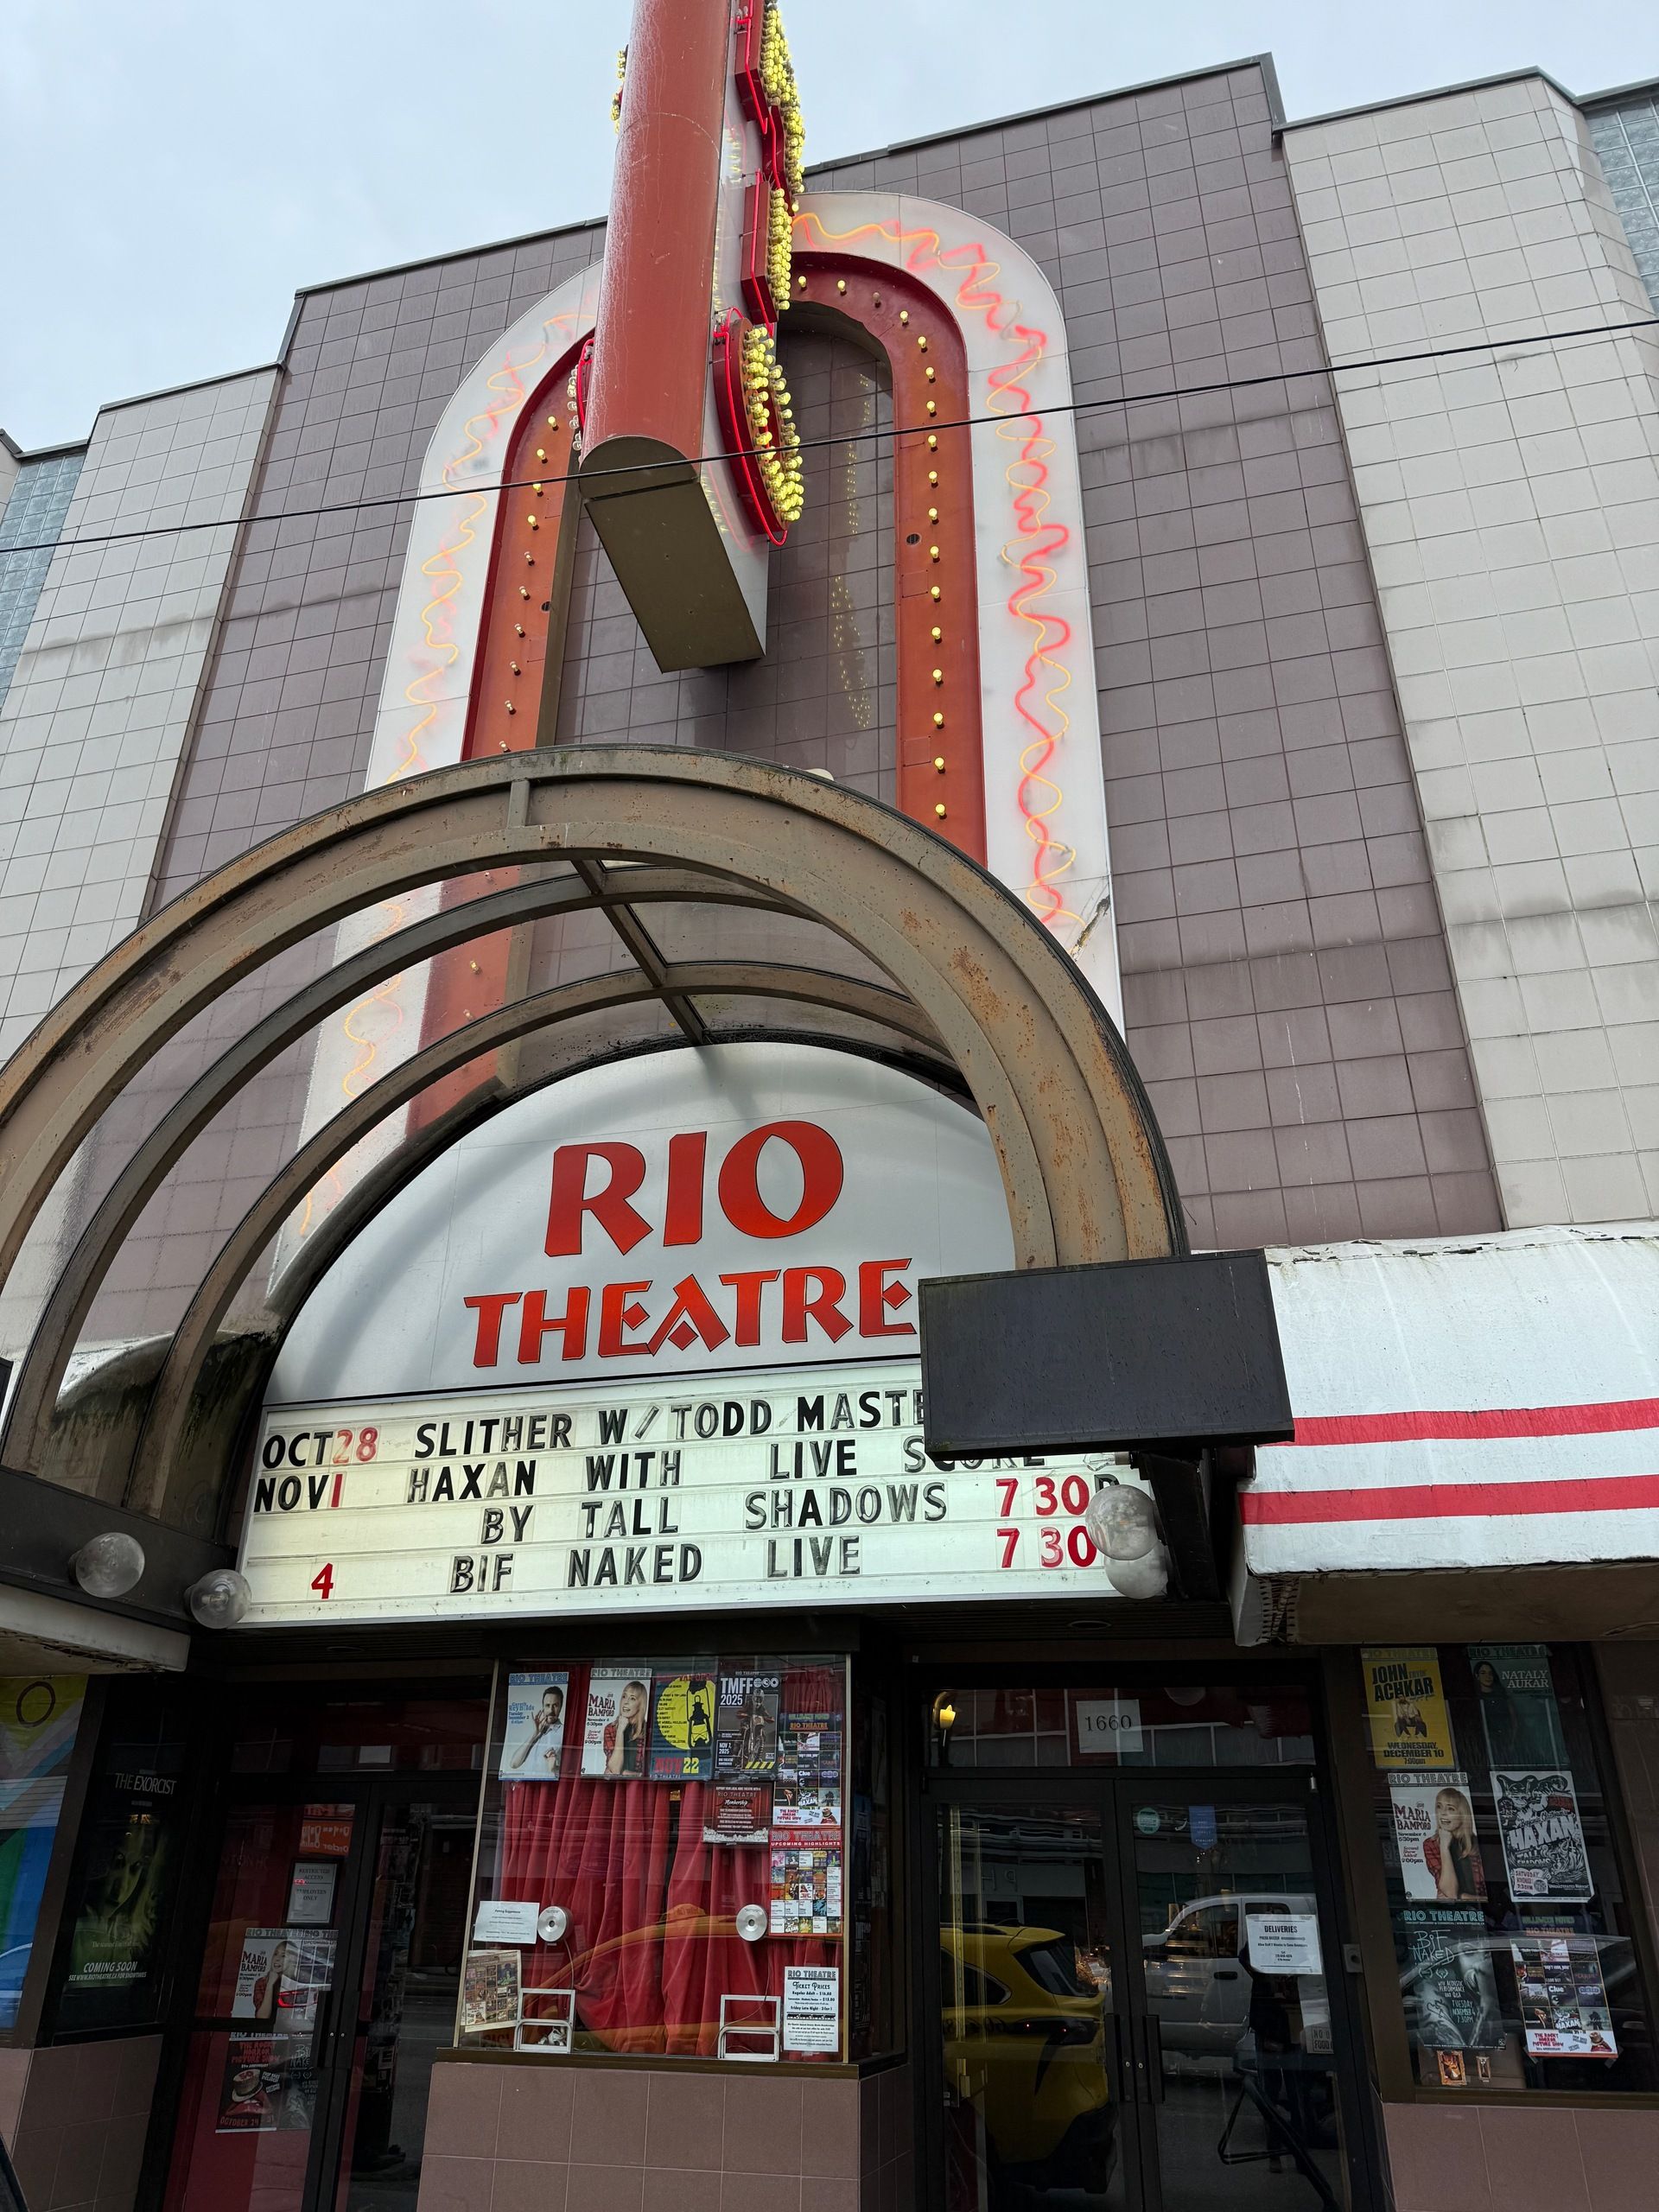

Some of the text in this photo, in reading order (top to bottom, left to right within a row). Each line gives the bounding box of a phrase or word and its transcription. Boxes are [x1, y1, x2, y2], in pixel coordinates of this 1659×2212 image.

[544, 1121, 843, 1256] RIO
[464, 1258, 917, 1368] THEATRE
[415, 1413, 572, 1458] SLITHER
[407, 1459, 536, 1503] HAXAN
[586, 1450, 680, 1491] WITH
[770, 1439, 857, 1480] LIVE
[481, 1504, 534, 1544] BY
[581, 1497, 678, 1538] TALL
[745, 1481, 948, 1529] SHADOWS
[311, 1562, 334, 1599] 4
[450, 1553, 514, 1593] BIF
[568, 1543, 702, 1587] NAKED
[768, 1535, 861, 1578] LIVE
[510, 1673, 568, 1682] RIO THEATRE
[591, 1668, 652, 1677] RIO THEATRE
[1372, 1662, 1408, 1685] JOHN
[1502, 1669, 1548, 1680] NATALY
[720, 1677, 753, 1694] TMFF
[1374, 1677, 1434, 1702] ACHKAR
[1507, 1679, 1549, 1688] AUKAR
[588, 1693, 616, 1710] MARIA
[720, 1694, 743, 1706] 2025
[588, 1707, 615, 1717] BAMFORD
[1085, 1715, 1131, 1732] 1660
[1434, 1749, 1444, 1758] 10
[115, 1772, 177, 1796] THE EXORCIST
[1389, 1773, 1467, 1783] RIO THEATRE
[1393, 1802, 1431, 1821] MARIA
[1396, 1819, 1431, 1831] BAMFORD
[772, 1830, 841, 1841] RIO THEATRE
[1509, 1815, 1574, 1851] HAXAN
[1403, 1910, 1484, 1922] RIO THEATRE
[241, 1951, 267, 1965] MARIA
[1412, 1942, 1455, 1965] NAKED
[83, 1961, 138, 1973] COMING SOON
[240, 1963, 266, 1973] BAMFORD
[804, 1970, 836, 1979] THEATRE
[1452, 1999, 1473, 2008] TUESDAY
[1314, 2039, 1330, 2050] FOOD
[219, 2115, 248, 2127] OCTOBER
